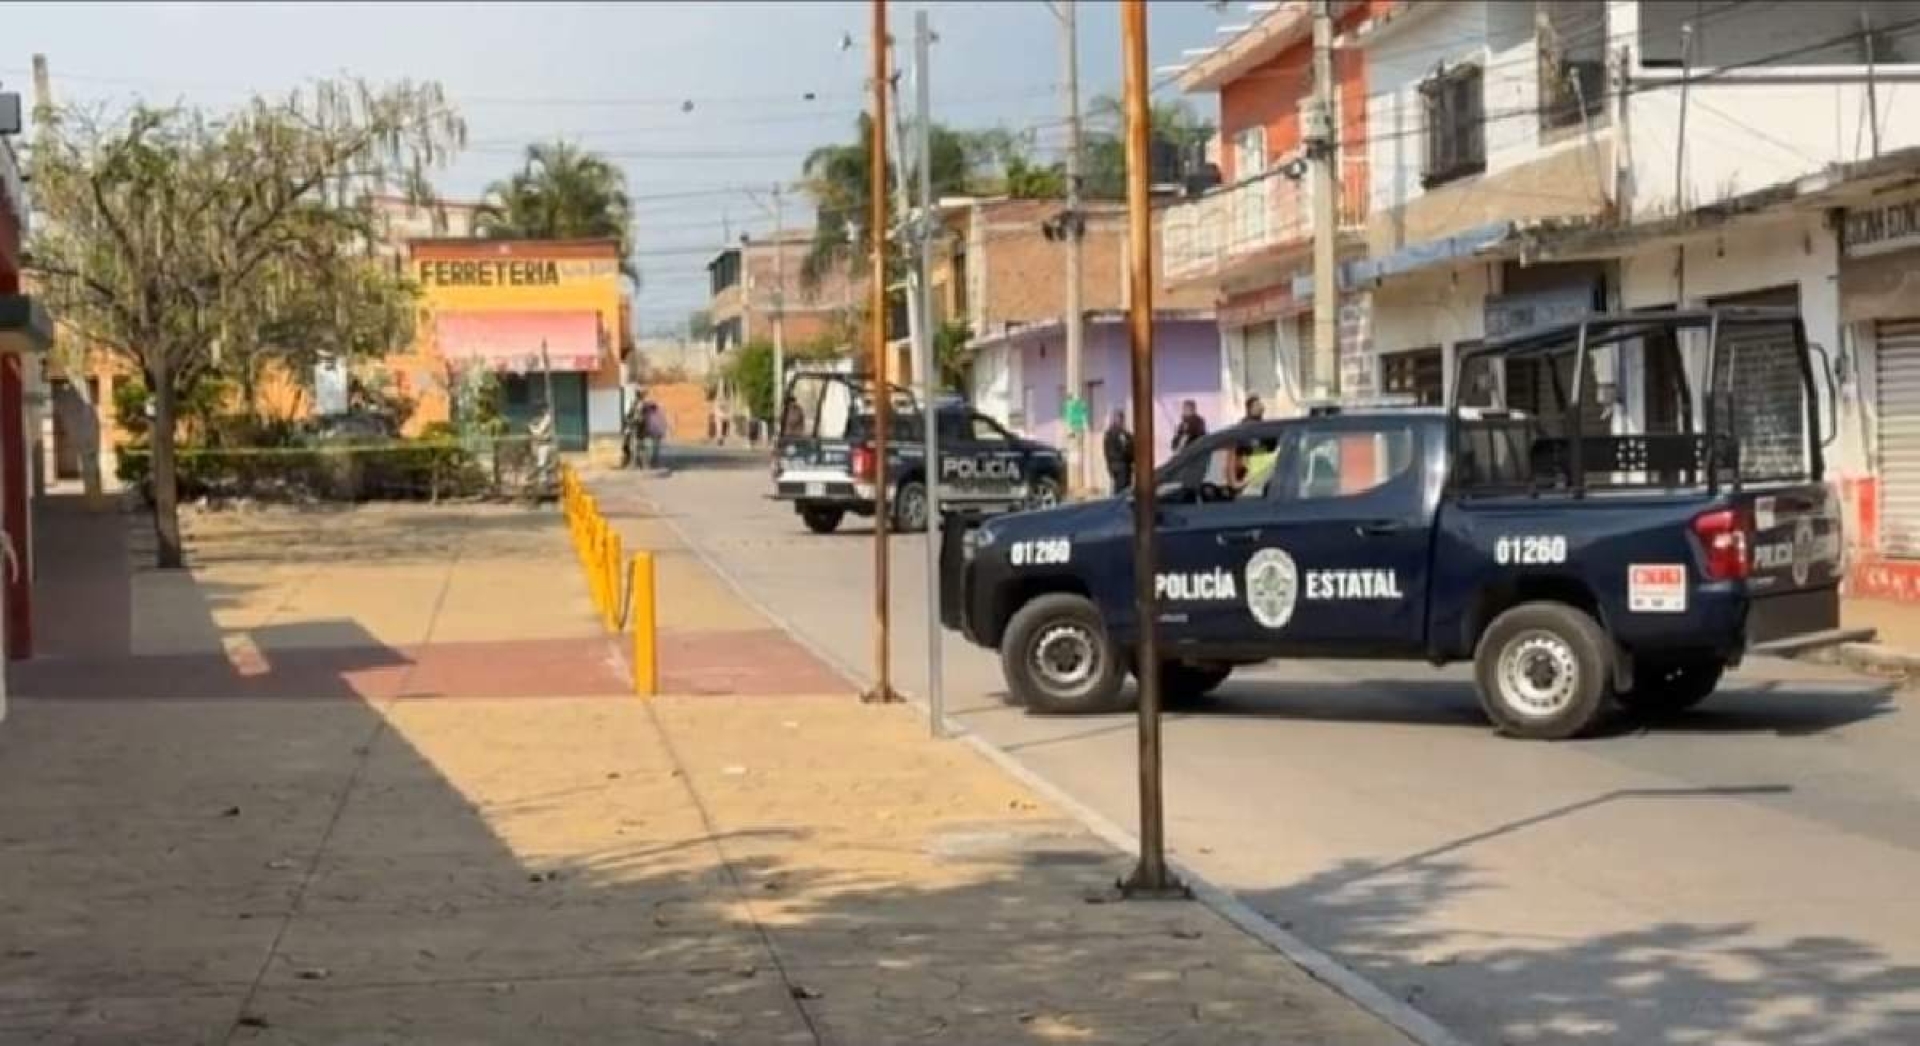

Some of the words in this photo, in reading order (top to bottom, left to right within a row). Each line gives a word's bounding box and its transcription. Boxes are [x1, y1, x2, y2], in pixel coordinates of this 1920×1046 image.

[419, 260, 560, 286] FERRETERIA
[1010, 536, 1071, 565] 01260
[1495, 535, 1567, 564] 01260
[1155, 566, 1236, 599] POLICÍA
[1306, 569, 1403, 599] ESTATAL
